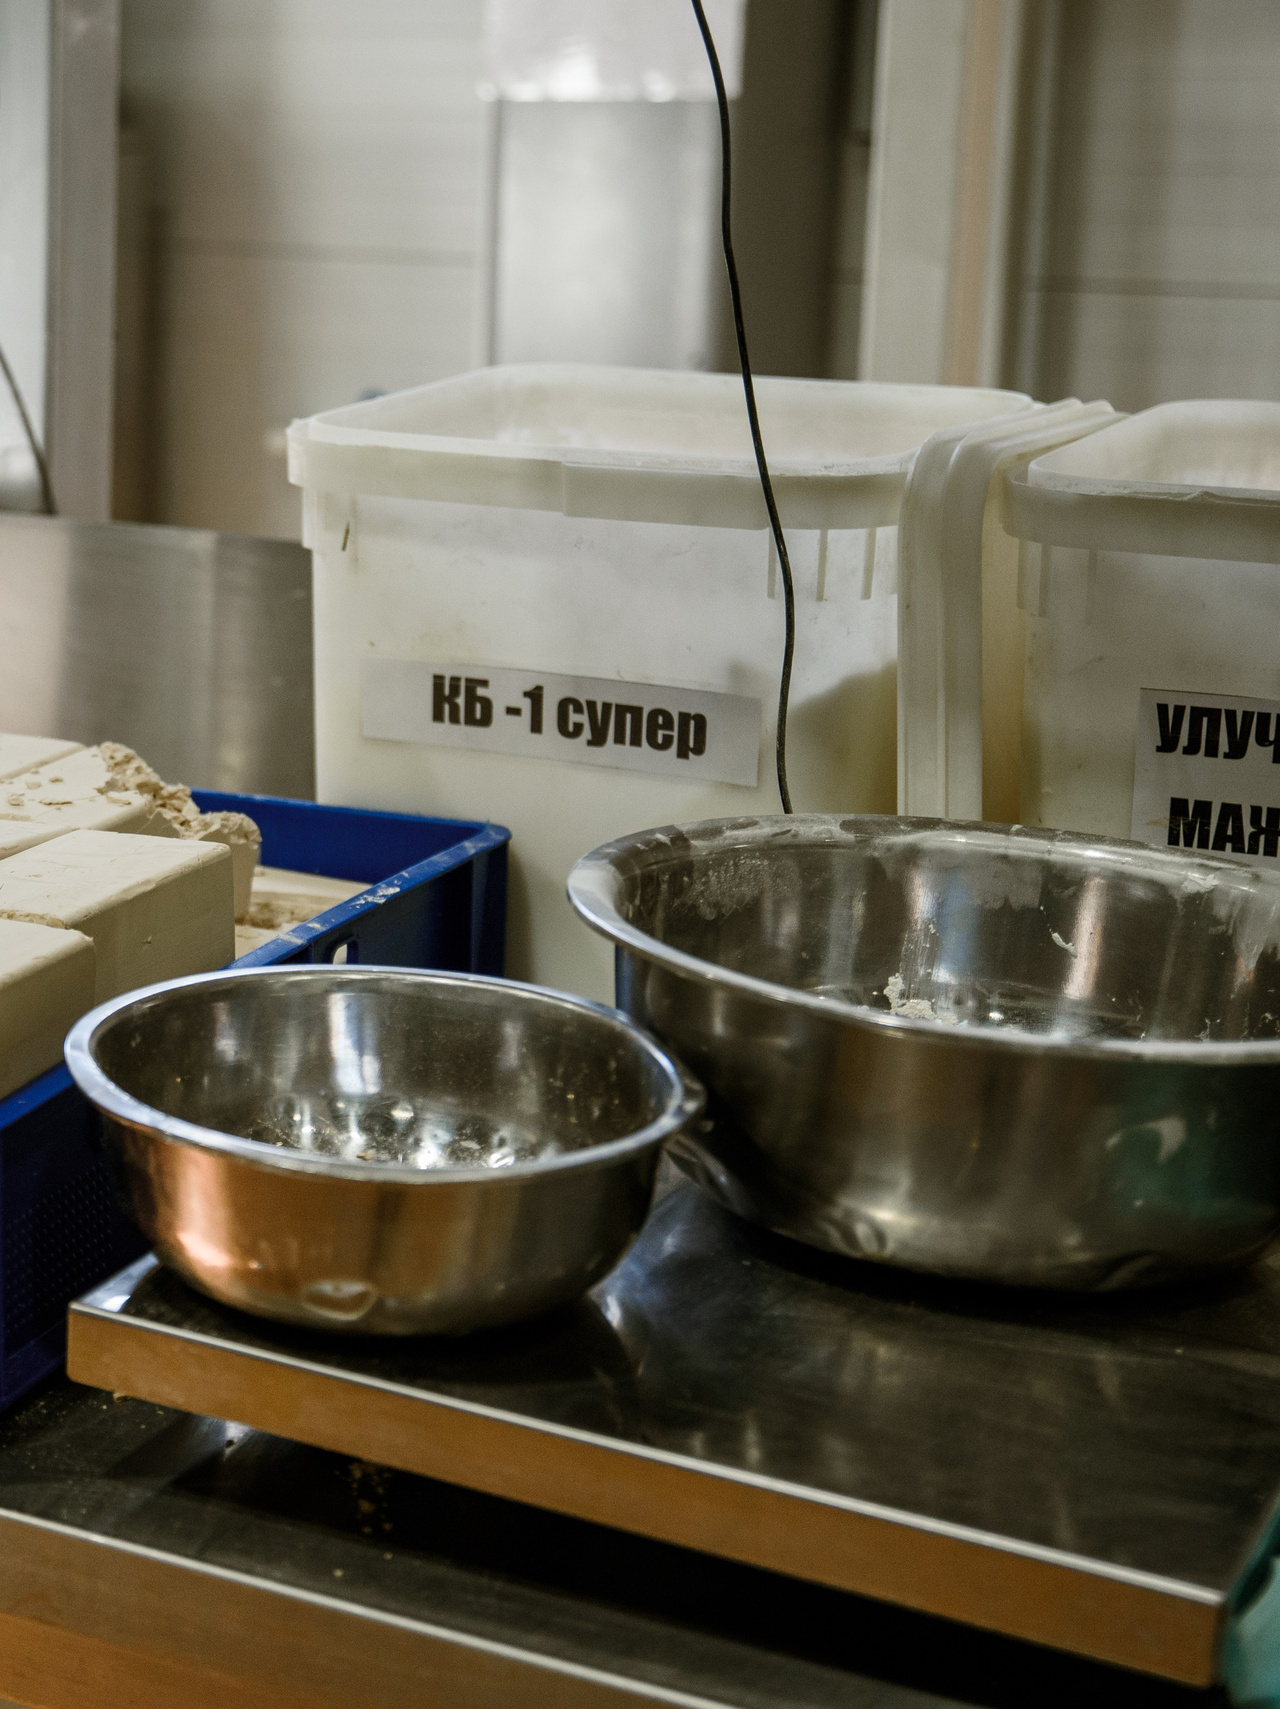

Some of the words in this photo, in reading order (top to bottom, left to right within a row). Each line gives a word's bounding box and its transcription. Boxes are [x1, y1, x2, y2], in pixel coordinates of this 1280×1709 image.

[432, 674, 493, 728] КБ
[505, 684, 544, 735] -1
[556, 696, 708, 761] супер
